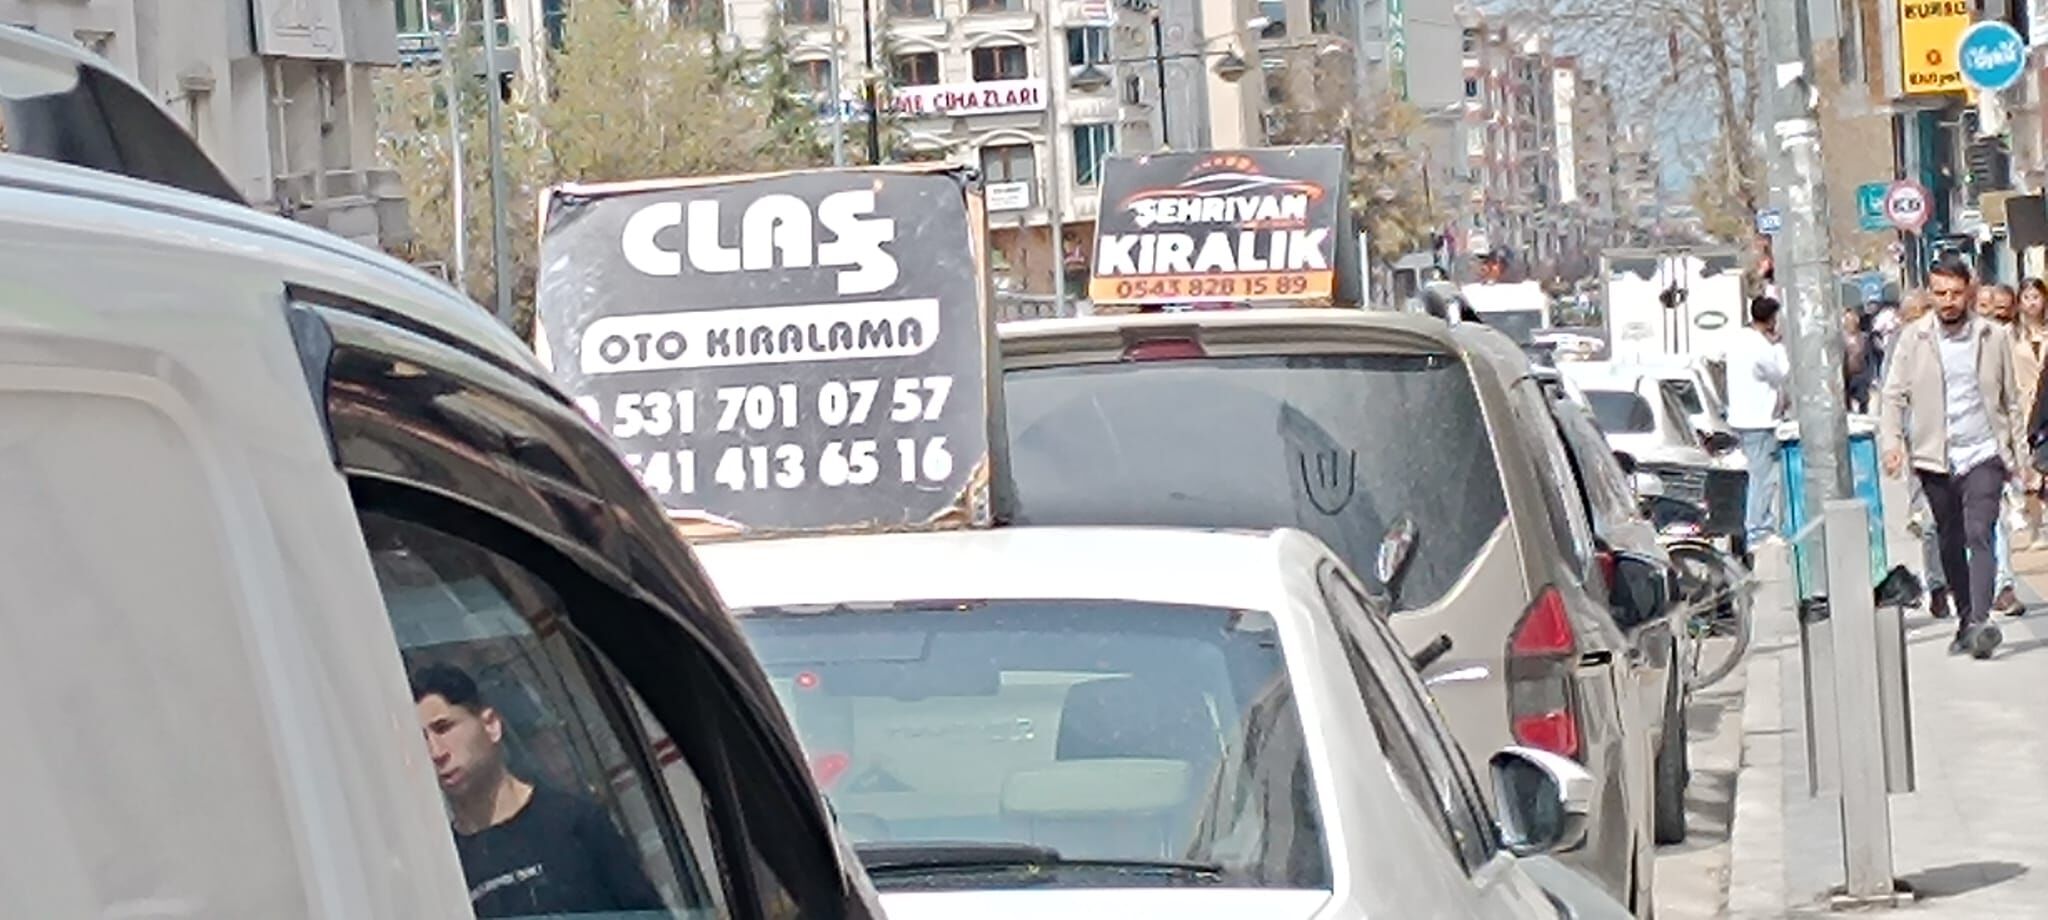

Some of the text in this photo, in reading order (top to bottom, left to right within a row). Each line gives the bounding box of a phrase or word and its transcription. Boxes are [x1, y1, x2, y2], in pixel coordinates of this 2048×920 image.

[1188, 277, 1235, 297] 828
[1245, 276, 1267, 295] 15
[1276, 275, 1308, 294] 89
[599, 316, 923, 364] OTO KIRALAMA
[612, 388, 695, 438] 531
[716, 383, 798, 432] 701
[818, 378, 881, 427] 07
[891, 375, 953, 422] 57
[715, 443, 805, 491] 413
[818, 439, 880, 487] 65
[897, 436, 954, 483] 16
